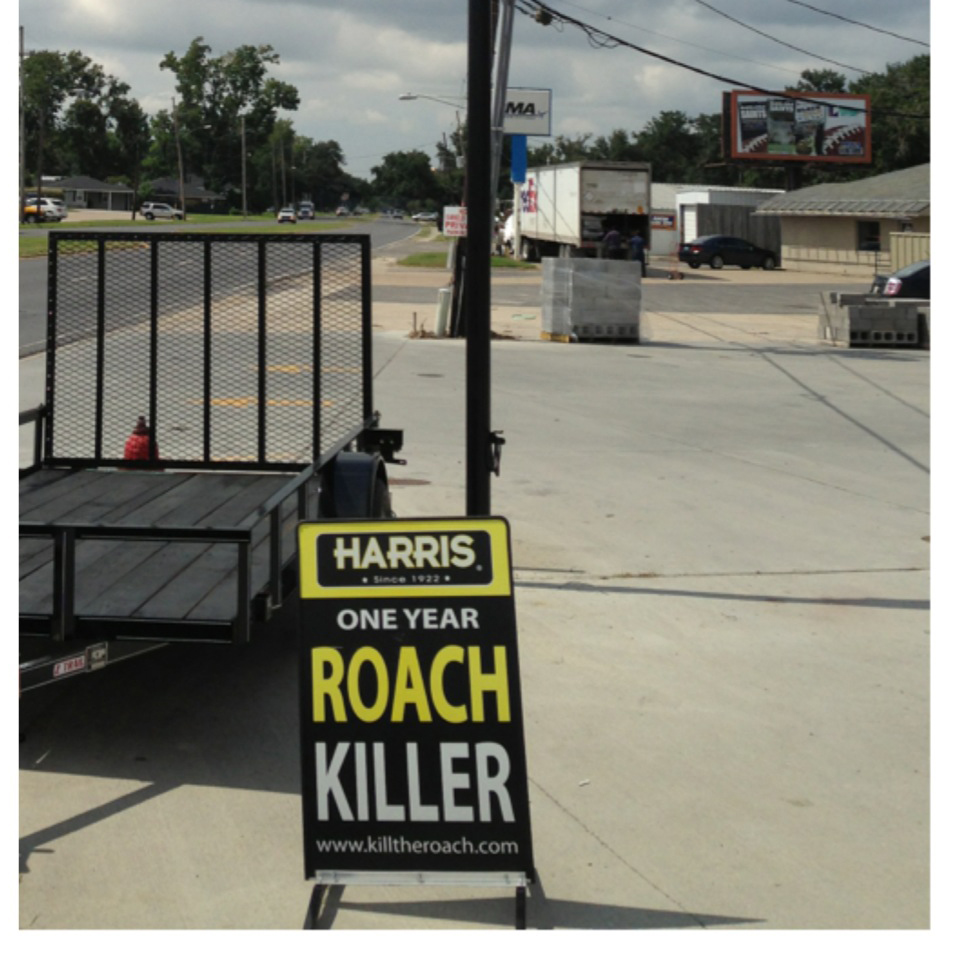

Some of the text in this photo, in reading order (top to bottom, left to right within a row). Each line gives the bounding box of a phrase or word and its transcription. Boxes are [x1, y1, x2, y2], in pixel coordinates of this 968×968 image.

[334, 534, 476, 570] HARRIS
[373, 574, 440, 584] Since 1922
[337, 608, 480, 630] ONE YEAR
[311, 645, 511, 723] ROACH
[315, 742, 516, 823] KILLER
[316, 836, 519, 855] www.killtheroach.com
